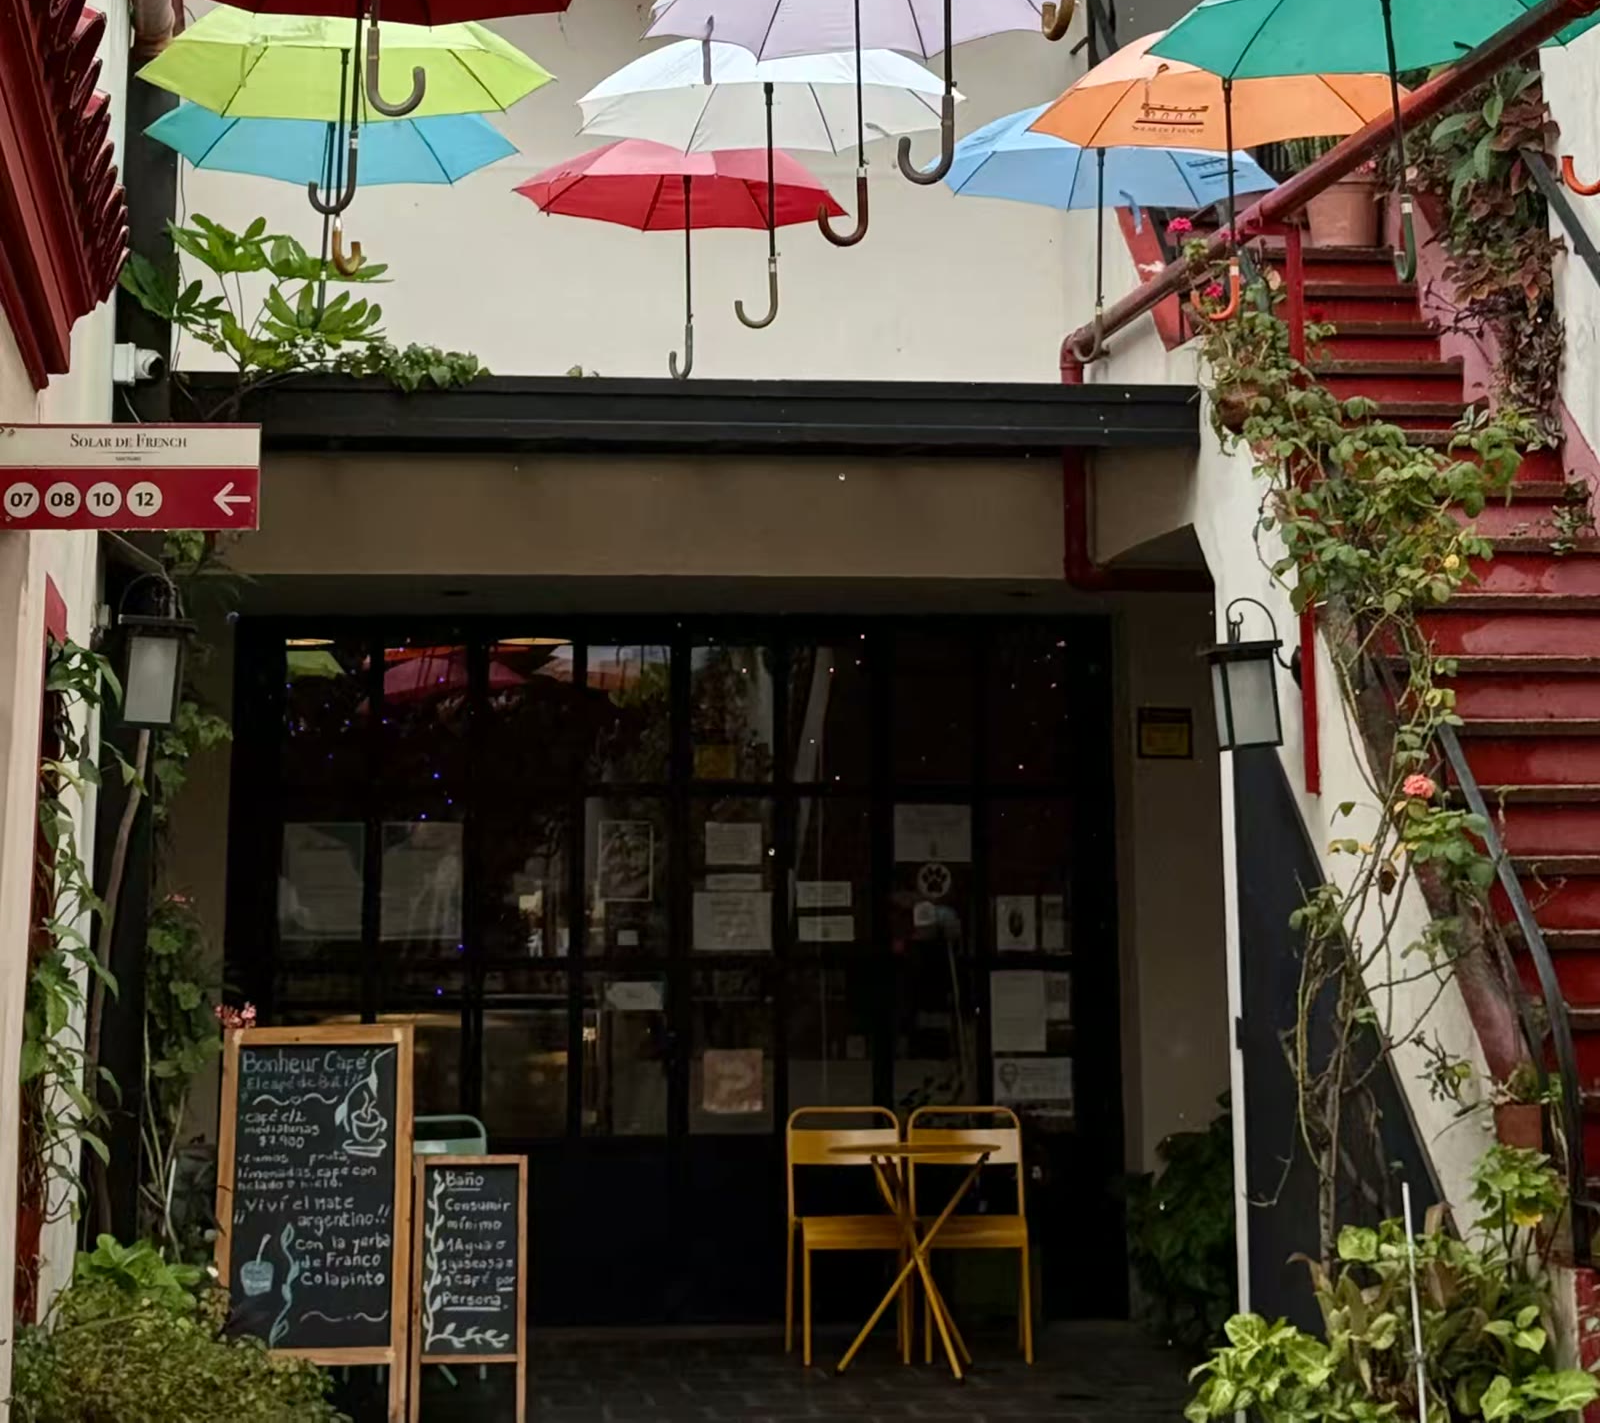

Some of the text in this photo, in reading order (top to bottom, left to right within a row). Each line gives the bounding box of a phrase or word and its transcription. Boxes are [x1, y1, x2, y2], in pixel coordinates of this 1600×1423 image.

[70, 433, 187, 448] SOLAR DE FRENCH
[10, 492, 154, 507] 07 08 10 12
[242, 1049, 321, 1074] Bonheur
[445, 1171, 485, 1187] Baño
[292, 1195, 309, 1210] el
[445, 1198, 512, 1212] Consumir
[332, 1235, 346, 1249] la
[326, 1252, 382, 1267] Franco
[300, 1272, 386, 1289] Colapinto
